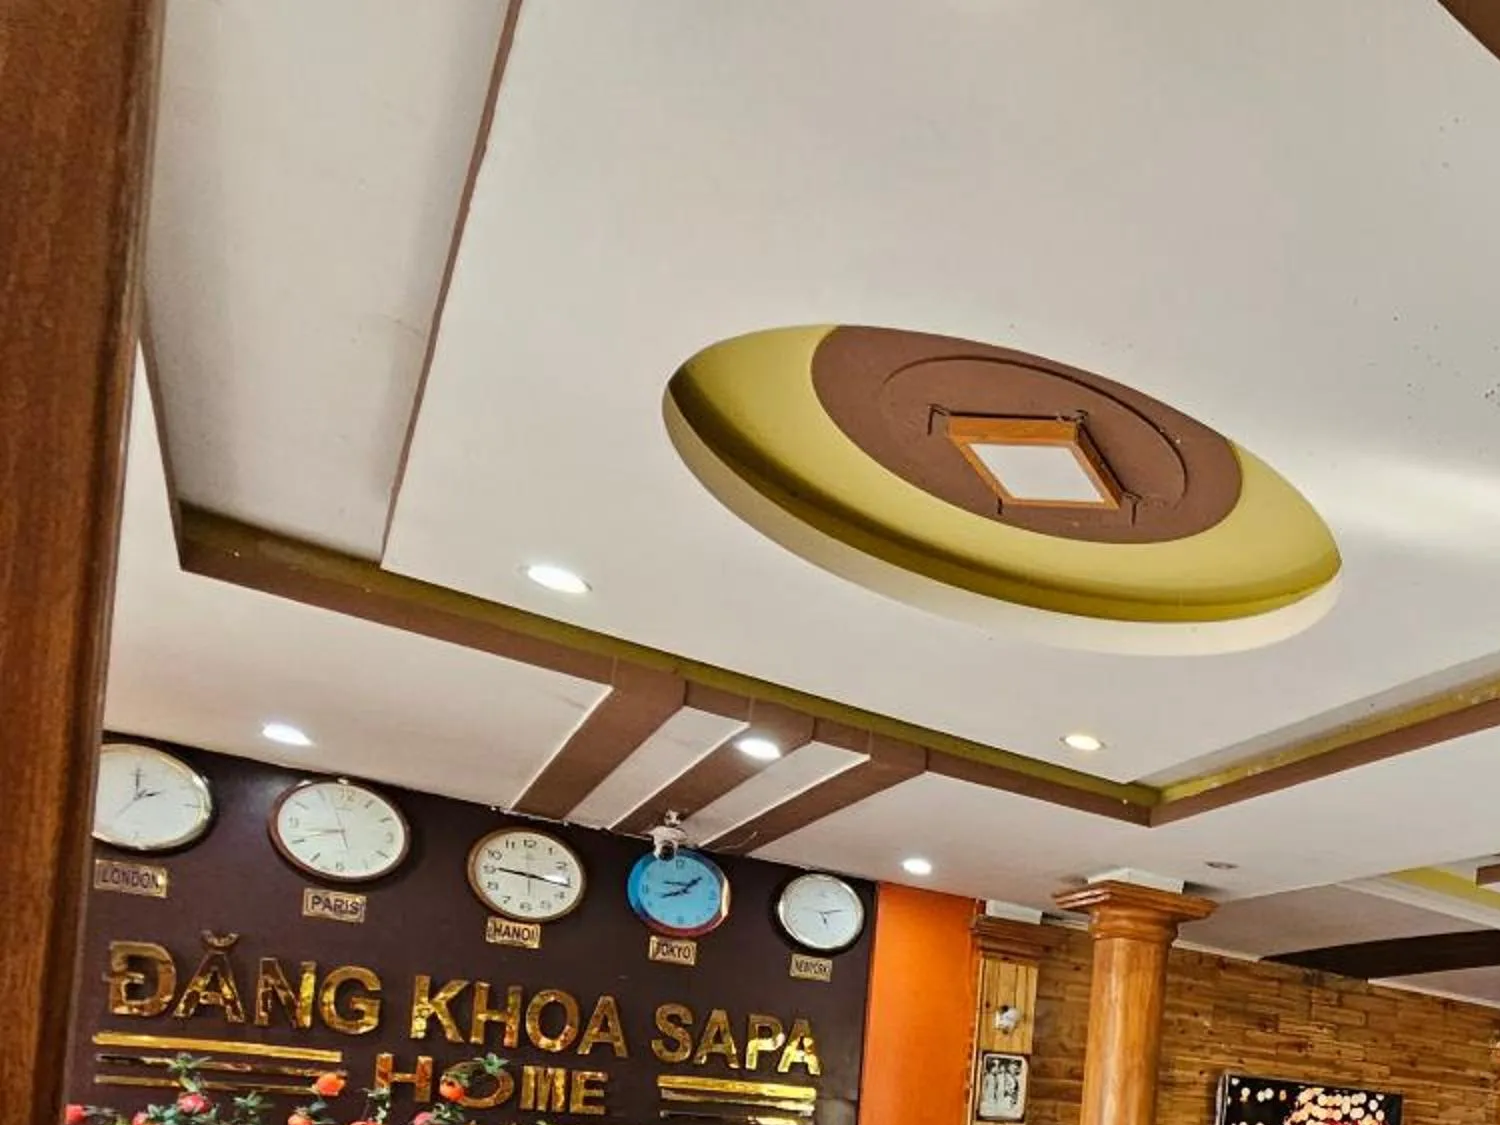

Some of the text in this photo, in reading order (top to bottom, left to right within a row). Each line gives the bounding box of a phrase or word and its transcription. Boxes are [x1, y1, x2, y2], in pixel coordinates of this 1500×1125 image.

[311, 895, 364, 915] PARIS
[493, 921, 536, 941] HANOI
[102, 929, 823, 1076] ĐĂNG KHOA SAPA
[373, 1052, 609, 1116] HOME
